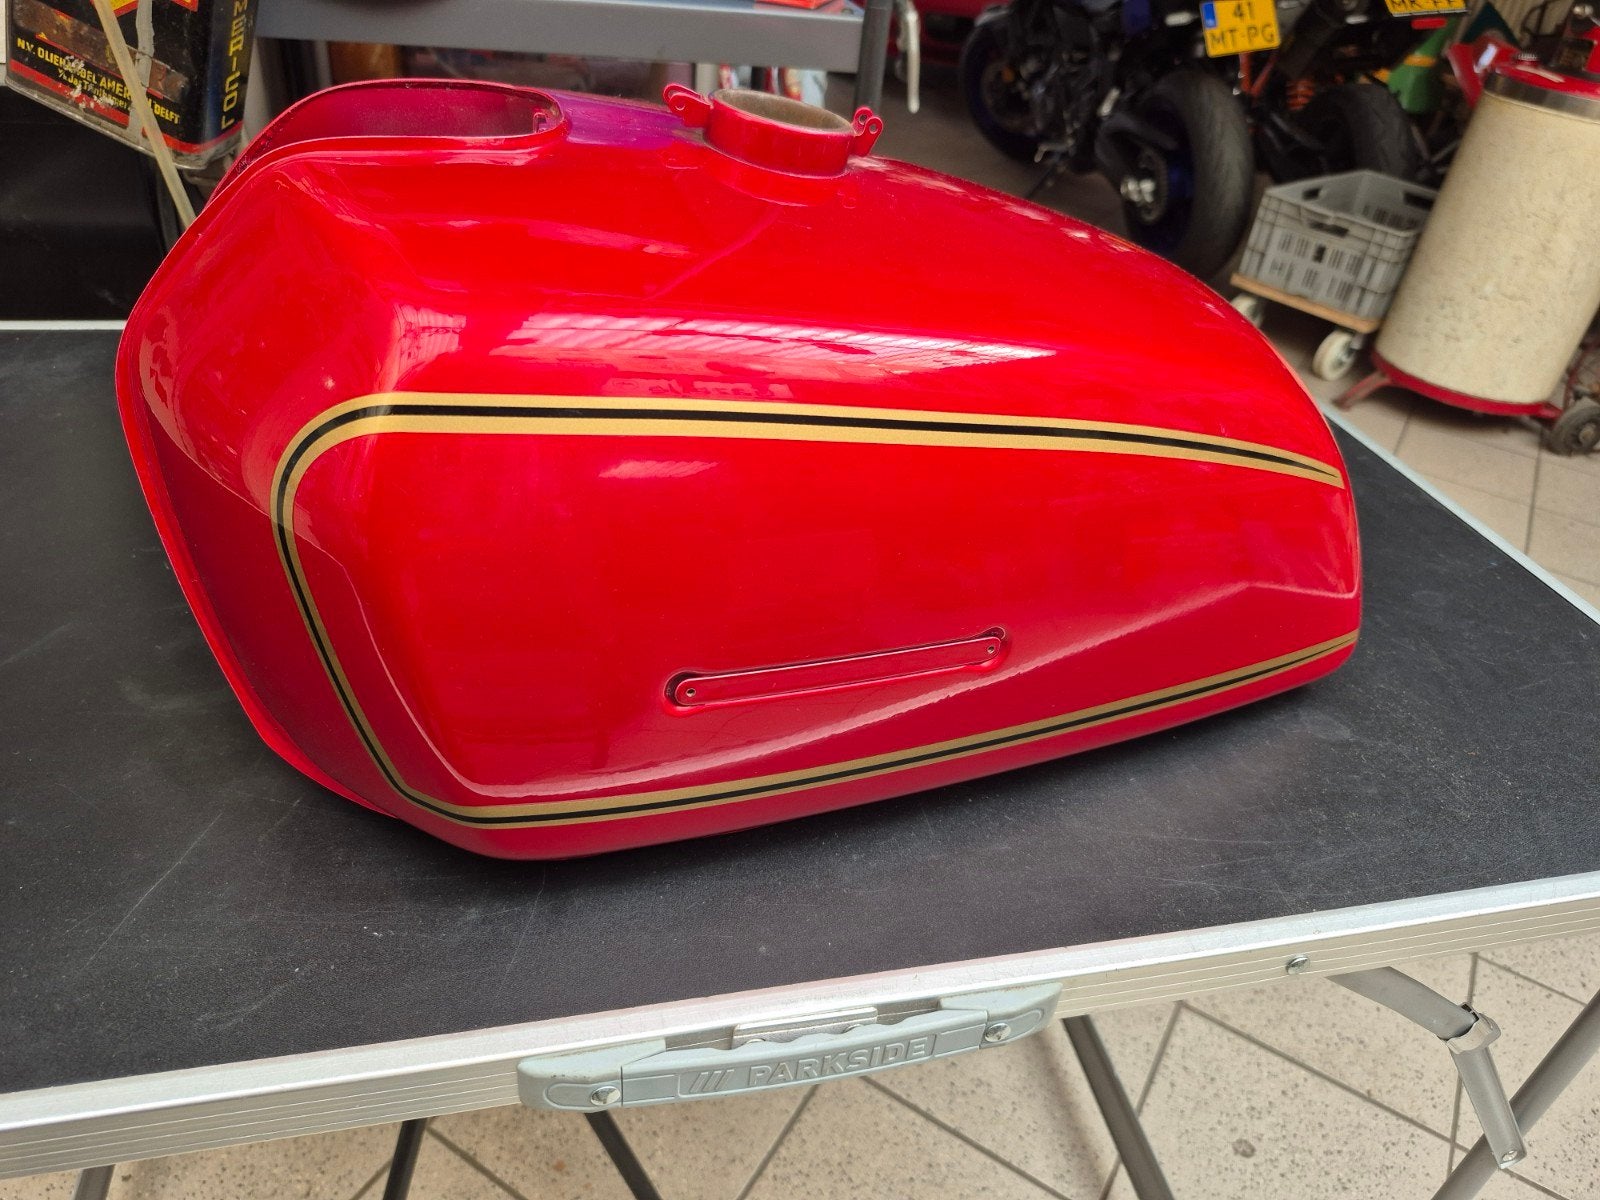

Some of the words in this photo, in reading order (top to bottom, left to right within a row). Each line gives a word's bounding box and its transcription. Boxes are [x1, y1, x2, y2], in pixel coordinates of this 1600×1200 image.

[1233, 2, 1255, 20] 41
[1209, 22, 1275, 48] MT-PG
[37, 46, 98, 84] OLIEHDEL
[153, 103, 181, 125] DELFT
[747, 1036, 929, 1087] PARKSIDE
